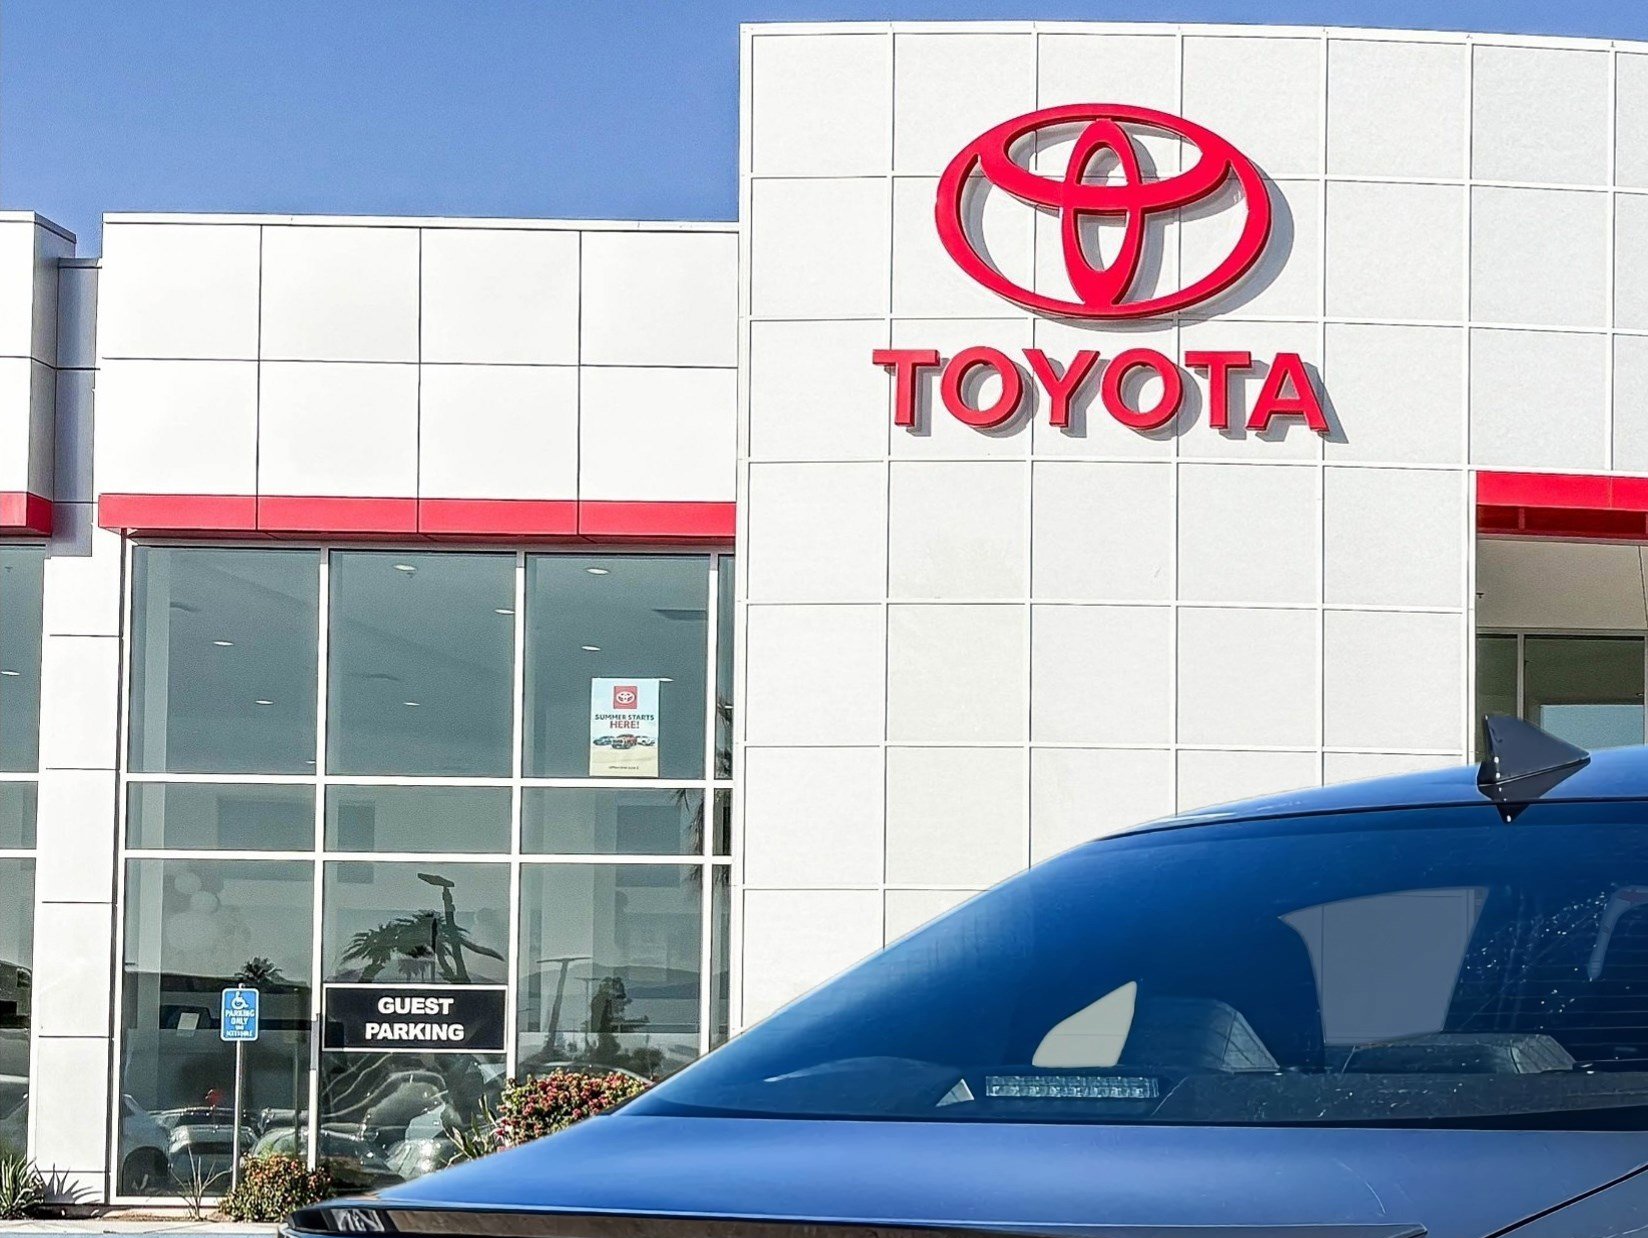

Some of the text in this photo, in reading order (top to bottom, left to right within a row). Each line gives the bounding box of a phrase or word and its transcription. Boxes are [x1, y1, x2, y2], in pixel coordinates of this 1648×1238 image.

[872, 345, 1330, 433] TOYOTA
[609, 720, 640, 729] HERE!
[377, 997, 455, 1015] GUEST
[365, 1022, 465, 1041] PARKING
